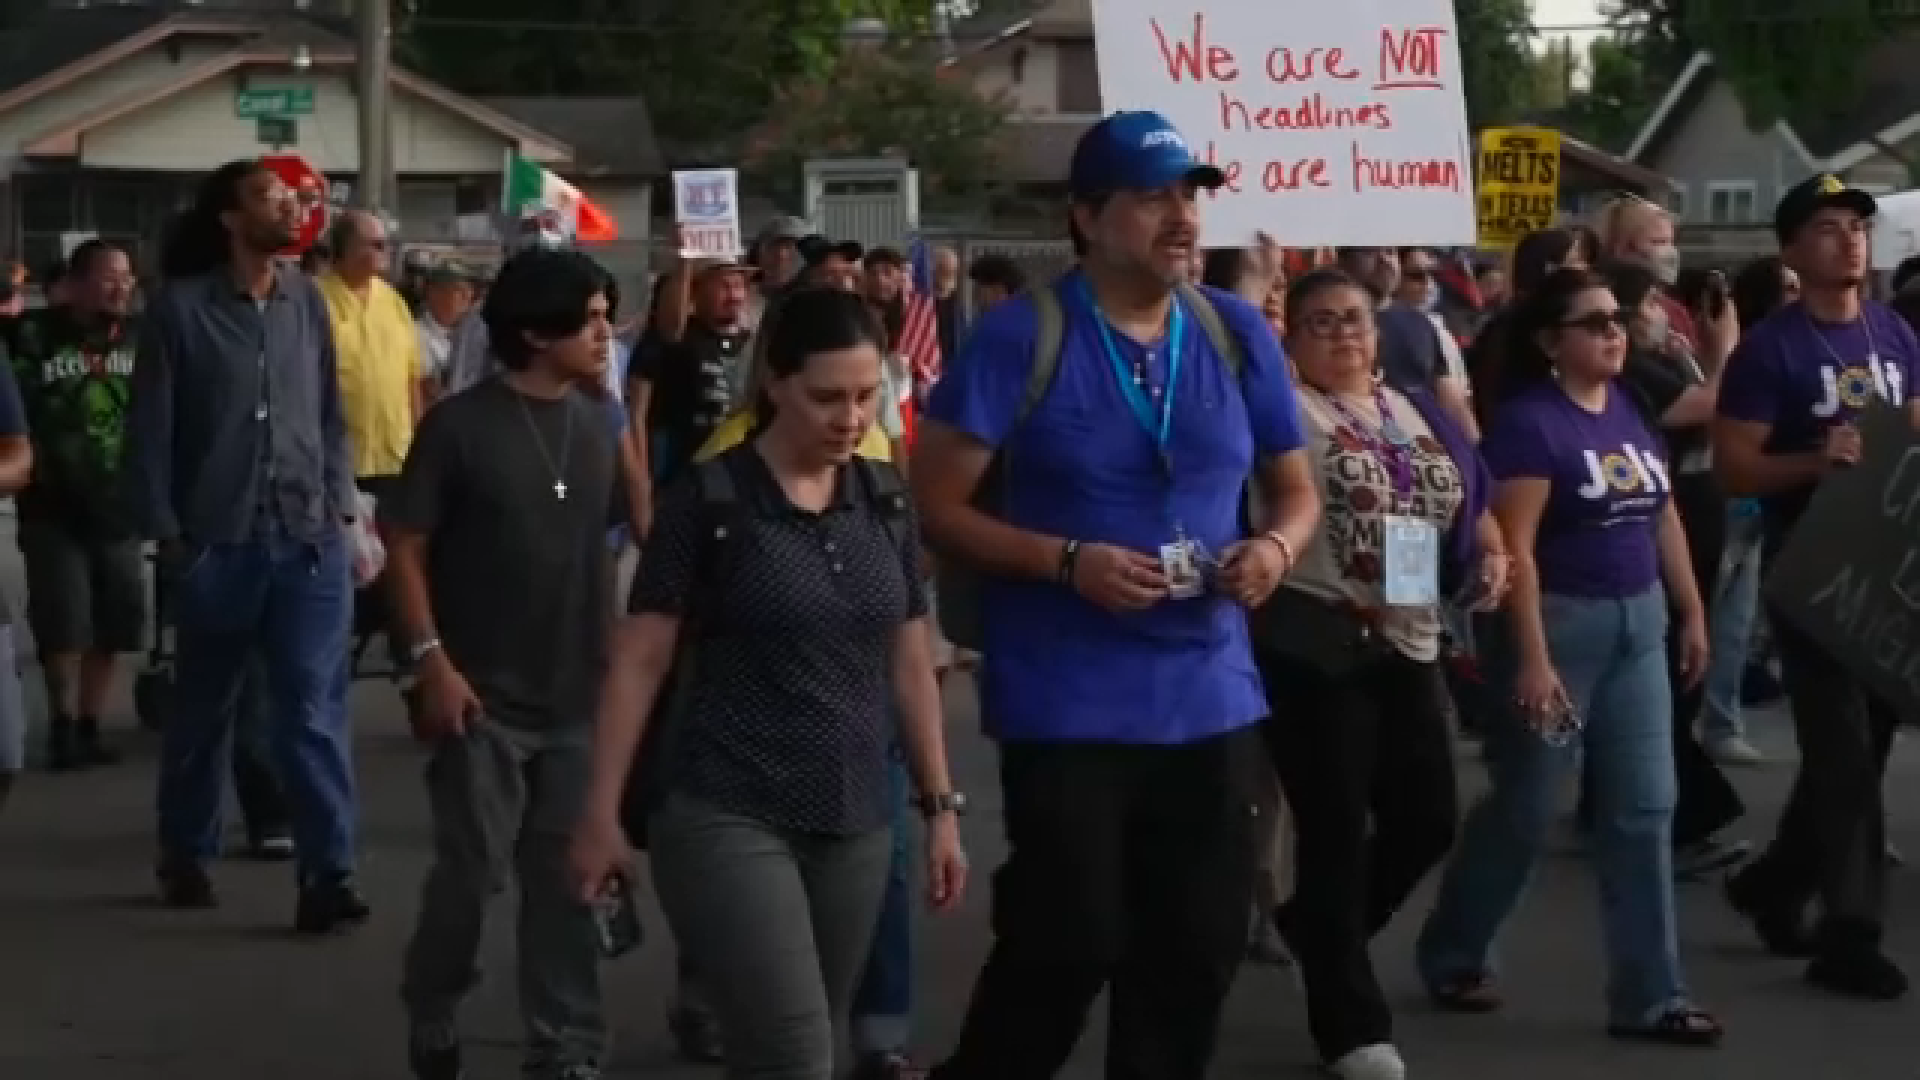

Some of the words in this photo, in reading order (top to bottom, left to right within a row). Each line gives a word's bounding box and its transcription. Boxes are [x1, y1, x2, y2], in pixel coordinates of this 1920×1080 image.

[1150, 12, 1240, 83] We
[1265, 45, 1360, 83] are
[1379, 26, 1449, 82] NOT
[1219, 90, 1391, 132] headlines
[1261, 158, 1332, 193] are
[1483, 152, 1555, 184] MELTS
